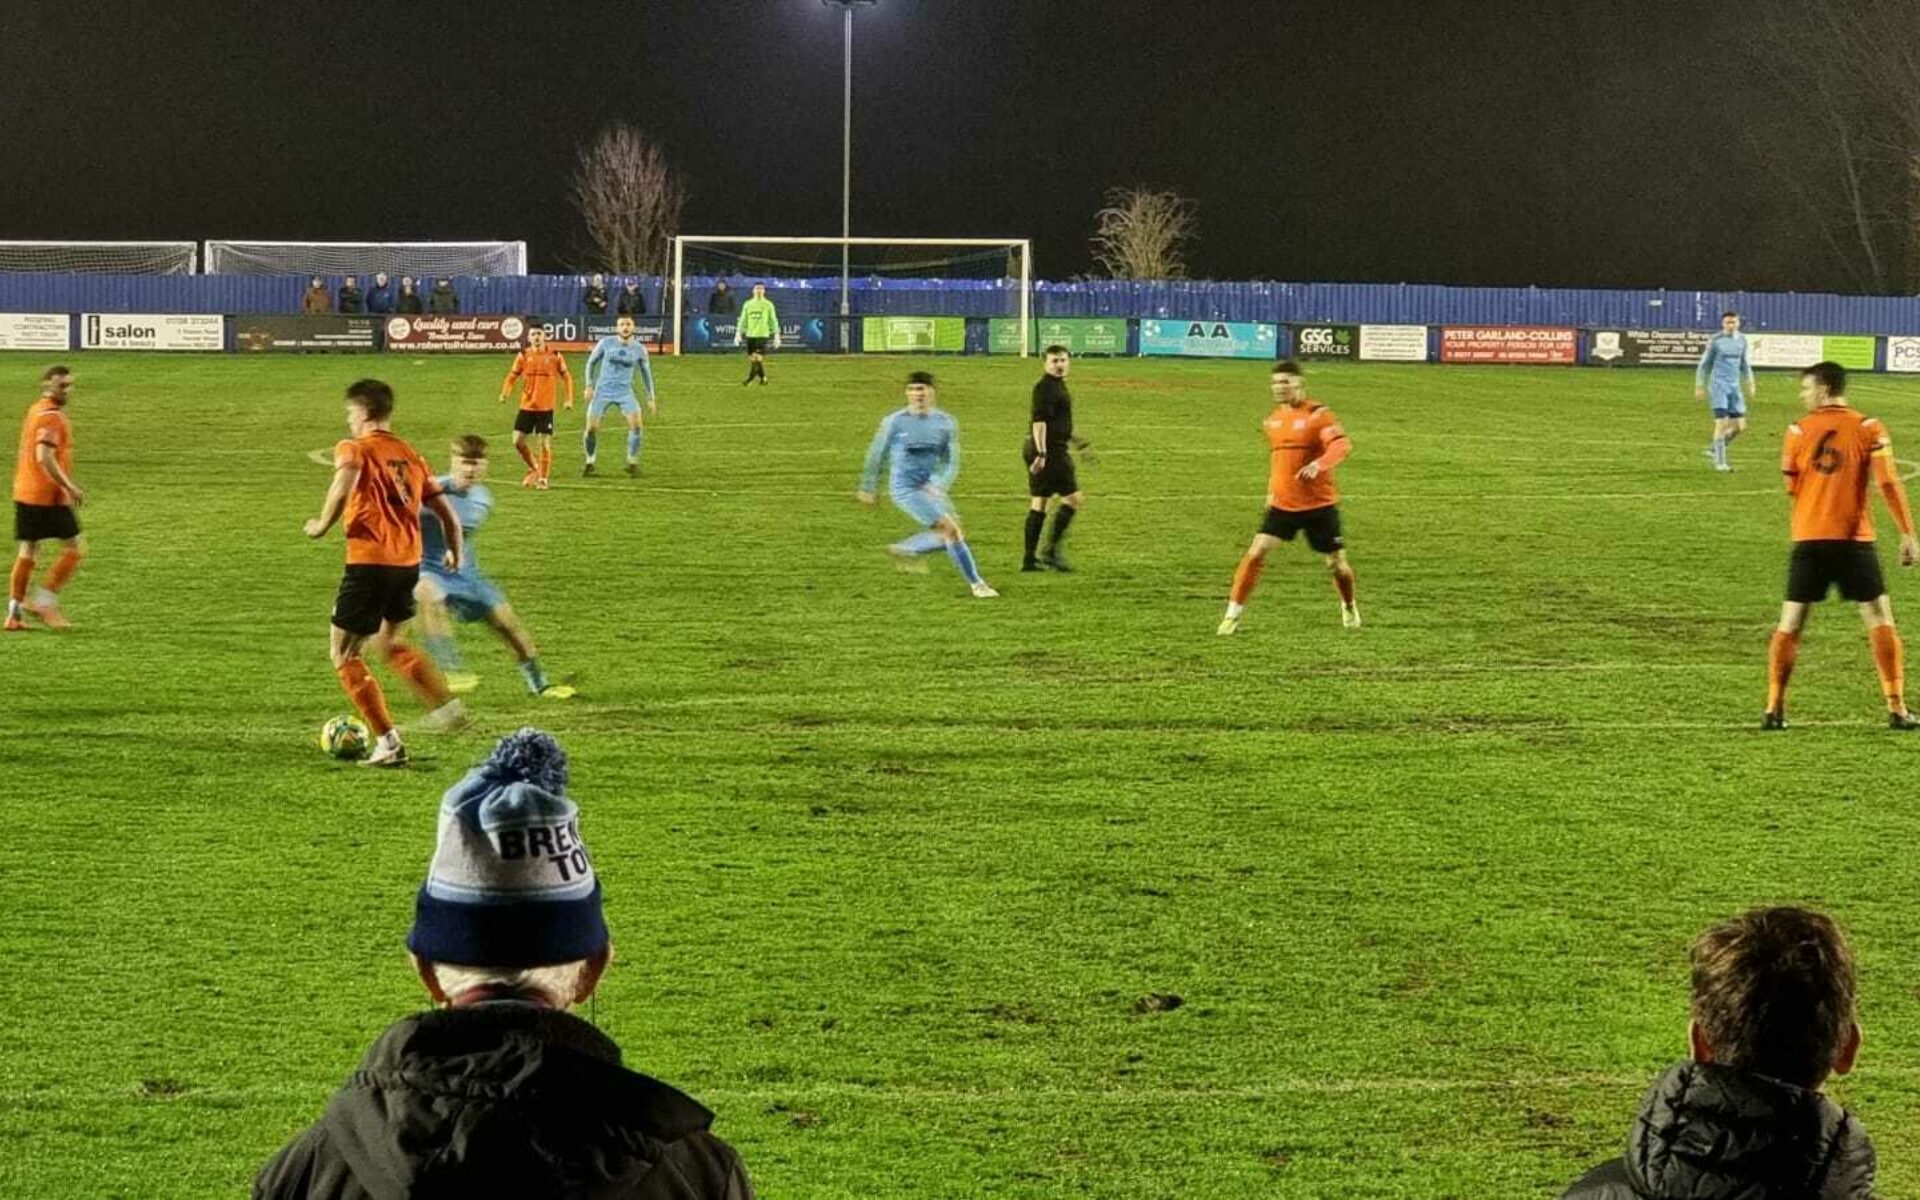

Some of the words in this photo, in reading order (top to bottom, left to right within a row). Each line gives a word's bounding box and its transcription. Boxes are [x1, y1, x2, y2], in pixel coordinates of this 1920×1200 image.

[105, 324, 156, 338] salon
[413, 317, 450, 332] Quality
[451, 317, 477, 330] used
[477, 320, 499, 330] cars
[1300, 328, 1333, 344] GSG
[1444, 330, 1474, 341] PETER
[1476, 330, 1573, 342] GARLAND-COLLINS
[1300, 344, 1350, 355] SERVICES
[1812, 430, 1844, 475] 6
